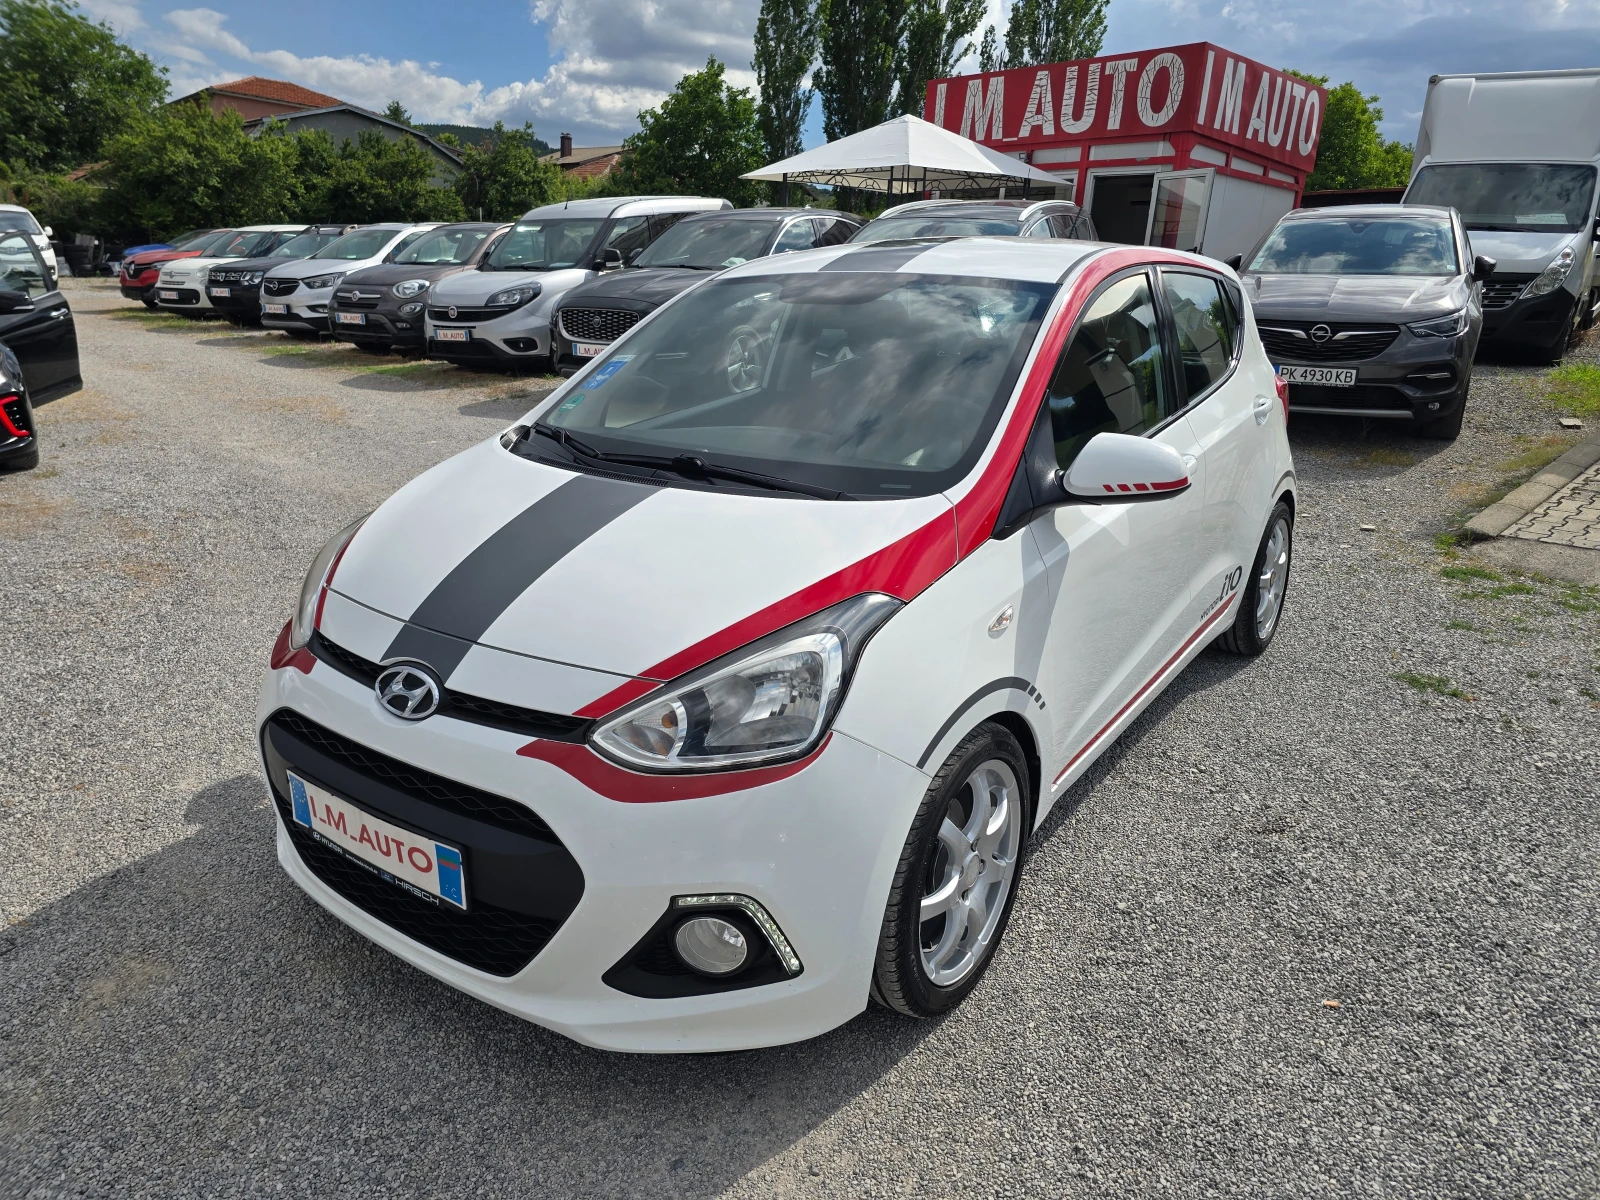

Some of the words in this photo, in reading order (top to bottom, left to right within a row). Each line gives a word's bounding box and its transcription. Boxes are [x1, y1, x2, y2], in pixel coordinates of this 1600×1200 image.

[1197, 50, 1215, 125] I
[1214, 57, 1246, 135] M
[1246, 71, 1319, 156] AUTO
[1281, 367, 1298, 380] PK
[1300, 369, 1333, 381] 4930
[1335, 371, 1353, 383] KB
[395, 878, 439, 905] HIRSCH
